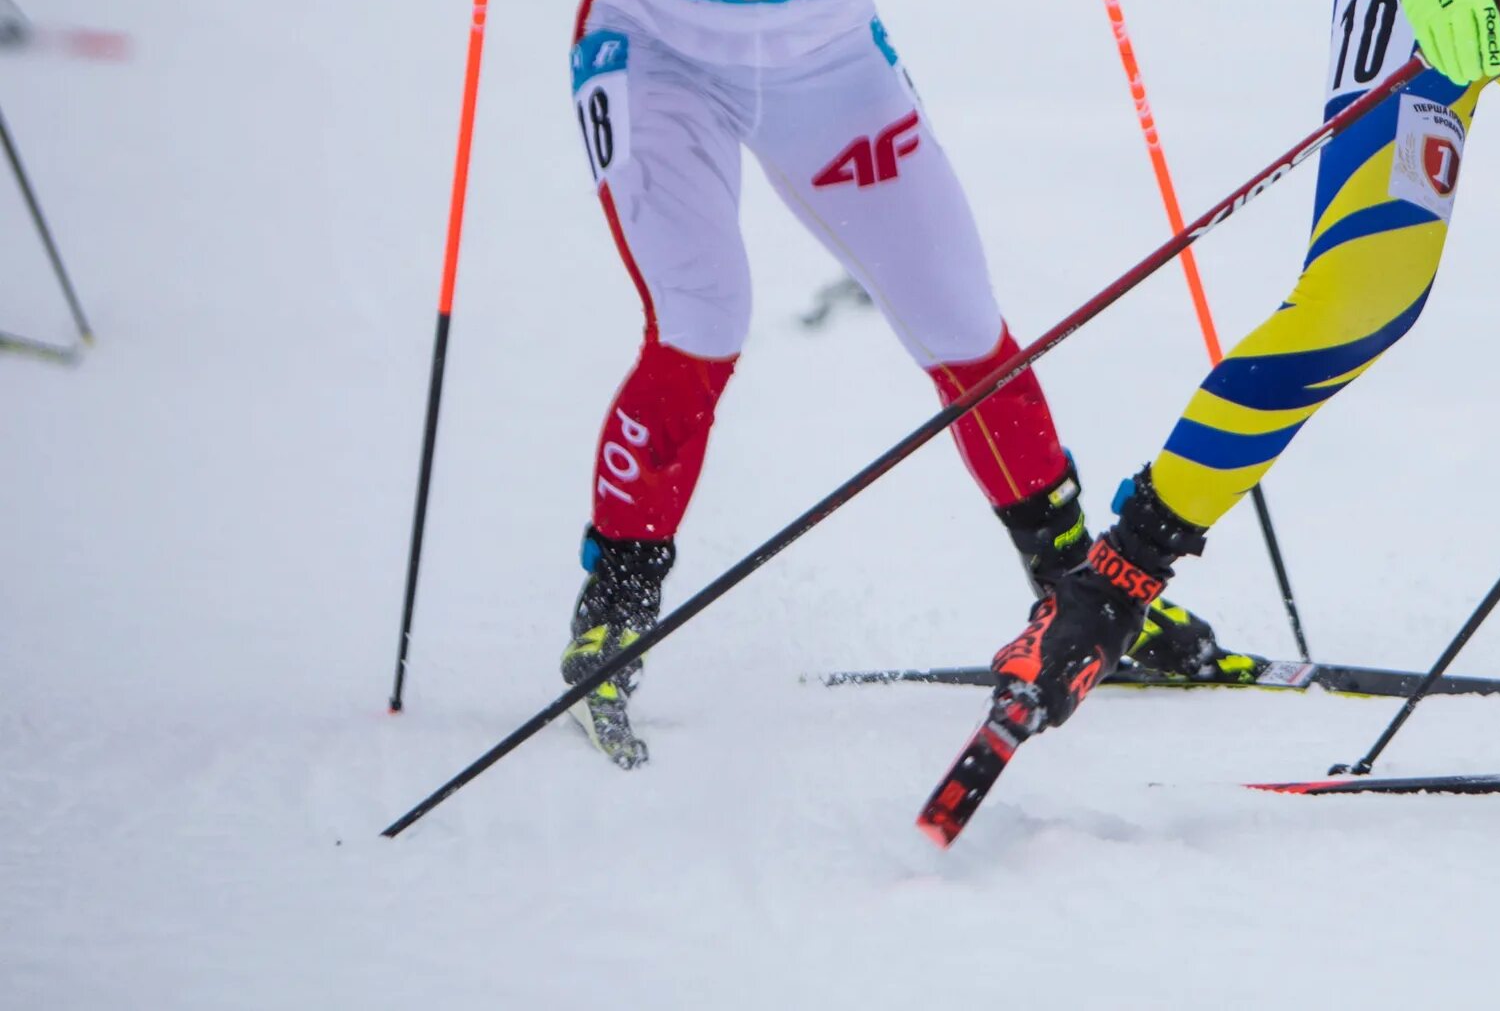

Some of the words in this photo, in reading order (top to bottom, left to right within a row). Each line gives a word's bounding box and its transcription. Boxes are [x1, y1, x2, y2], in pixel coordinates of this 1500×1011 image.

[576, 85, 615, 182] 18
[597, 406, 650, 505] POL
[1094, 545, 1156, 602] ROSS
